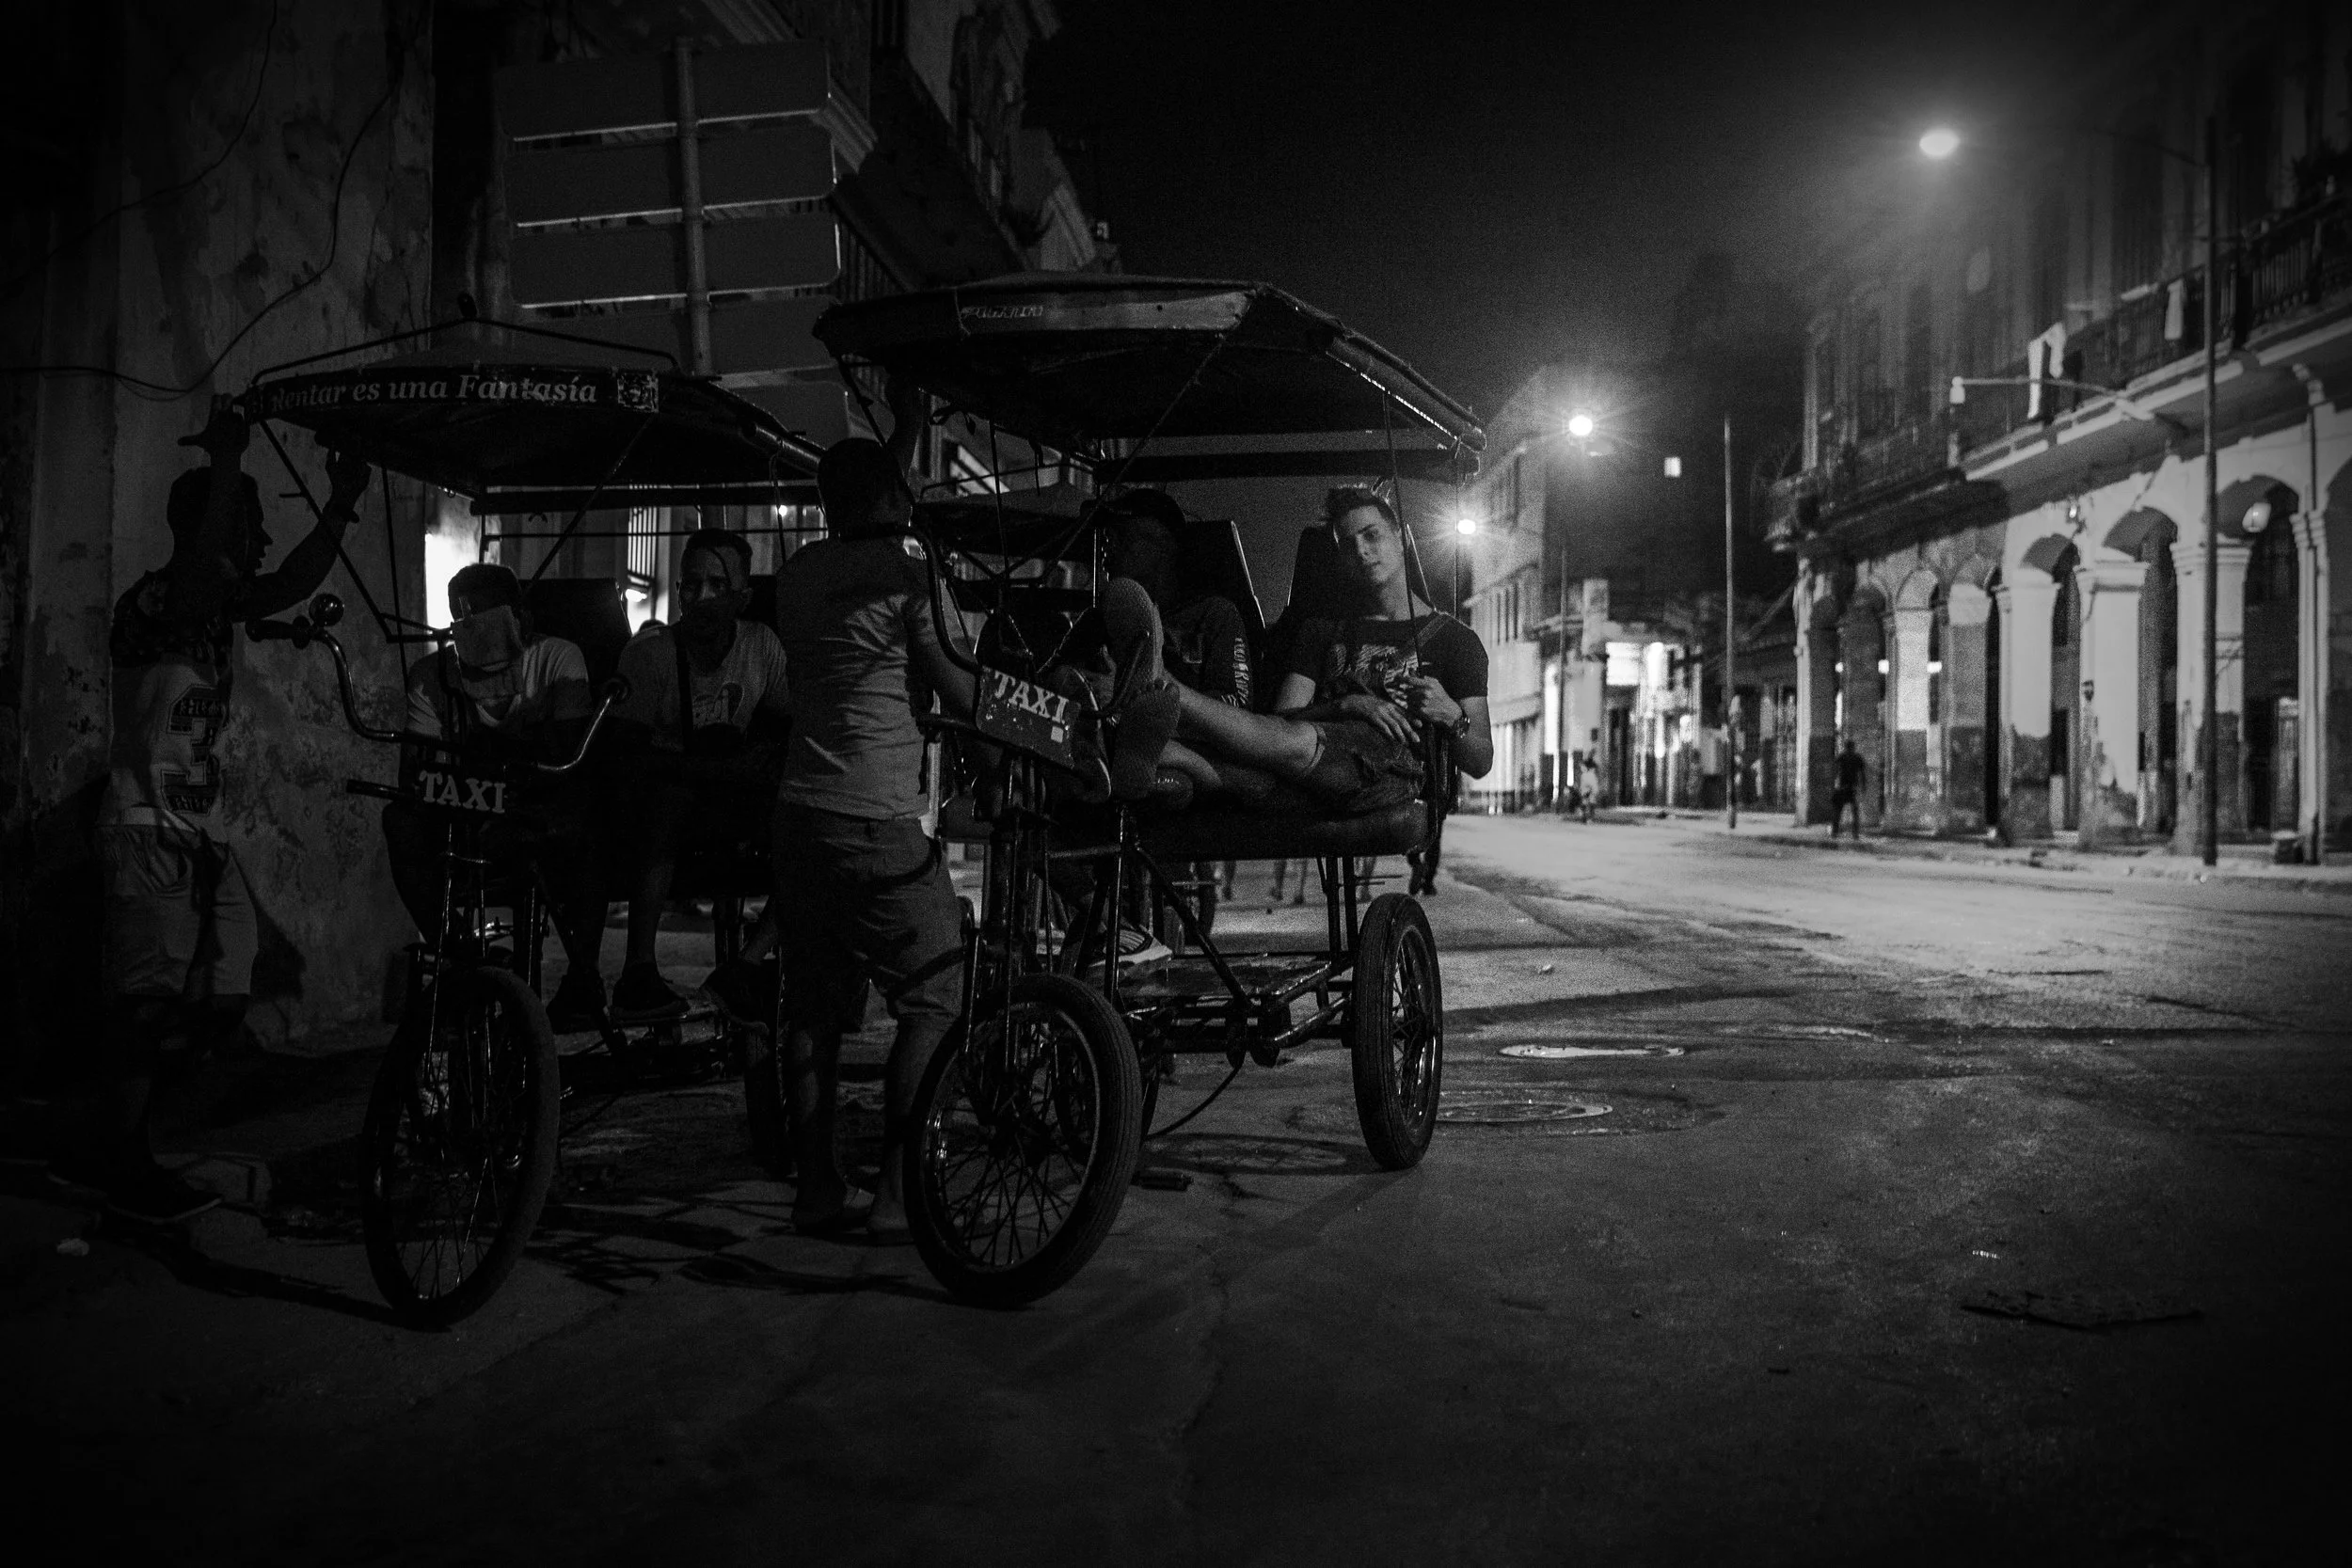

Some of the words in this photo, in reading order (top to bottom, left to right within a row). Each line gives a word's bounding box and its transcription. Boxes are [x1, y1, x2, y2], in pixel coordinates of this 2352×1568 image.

[352, 382, 381, 403] es
[388, 380, 449, 401] una
[458, 374, 597, 404] Fantasía
[994, 670, 1070, 724] TAXI
[419, 769, 507, 815] TAXI
